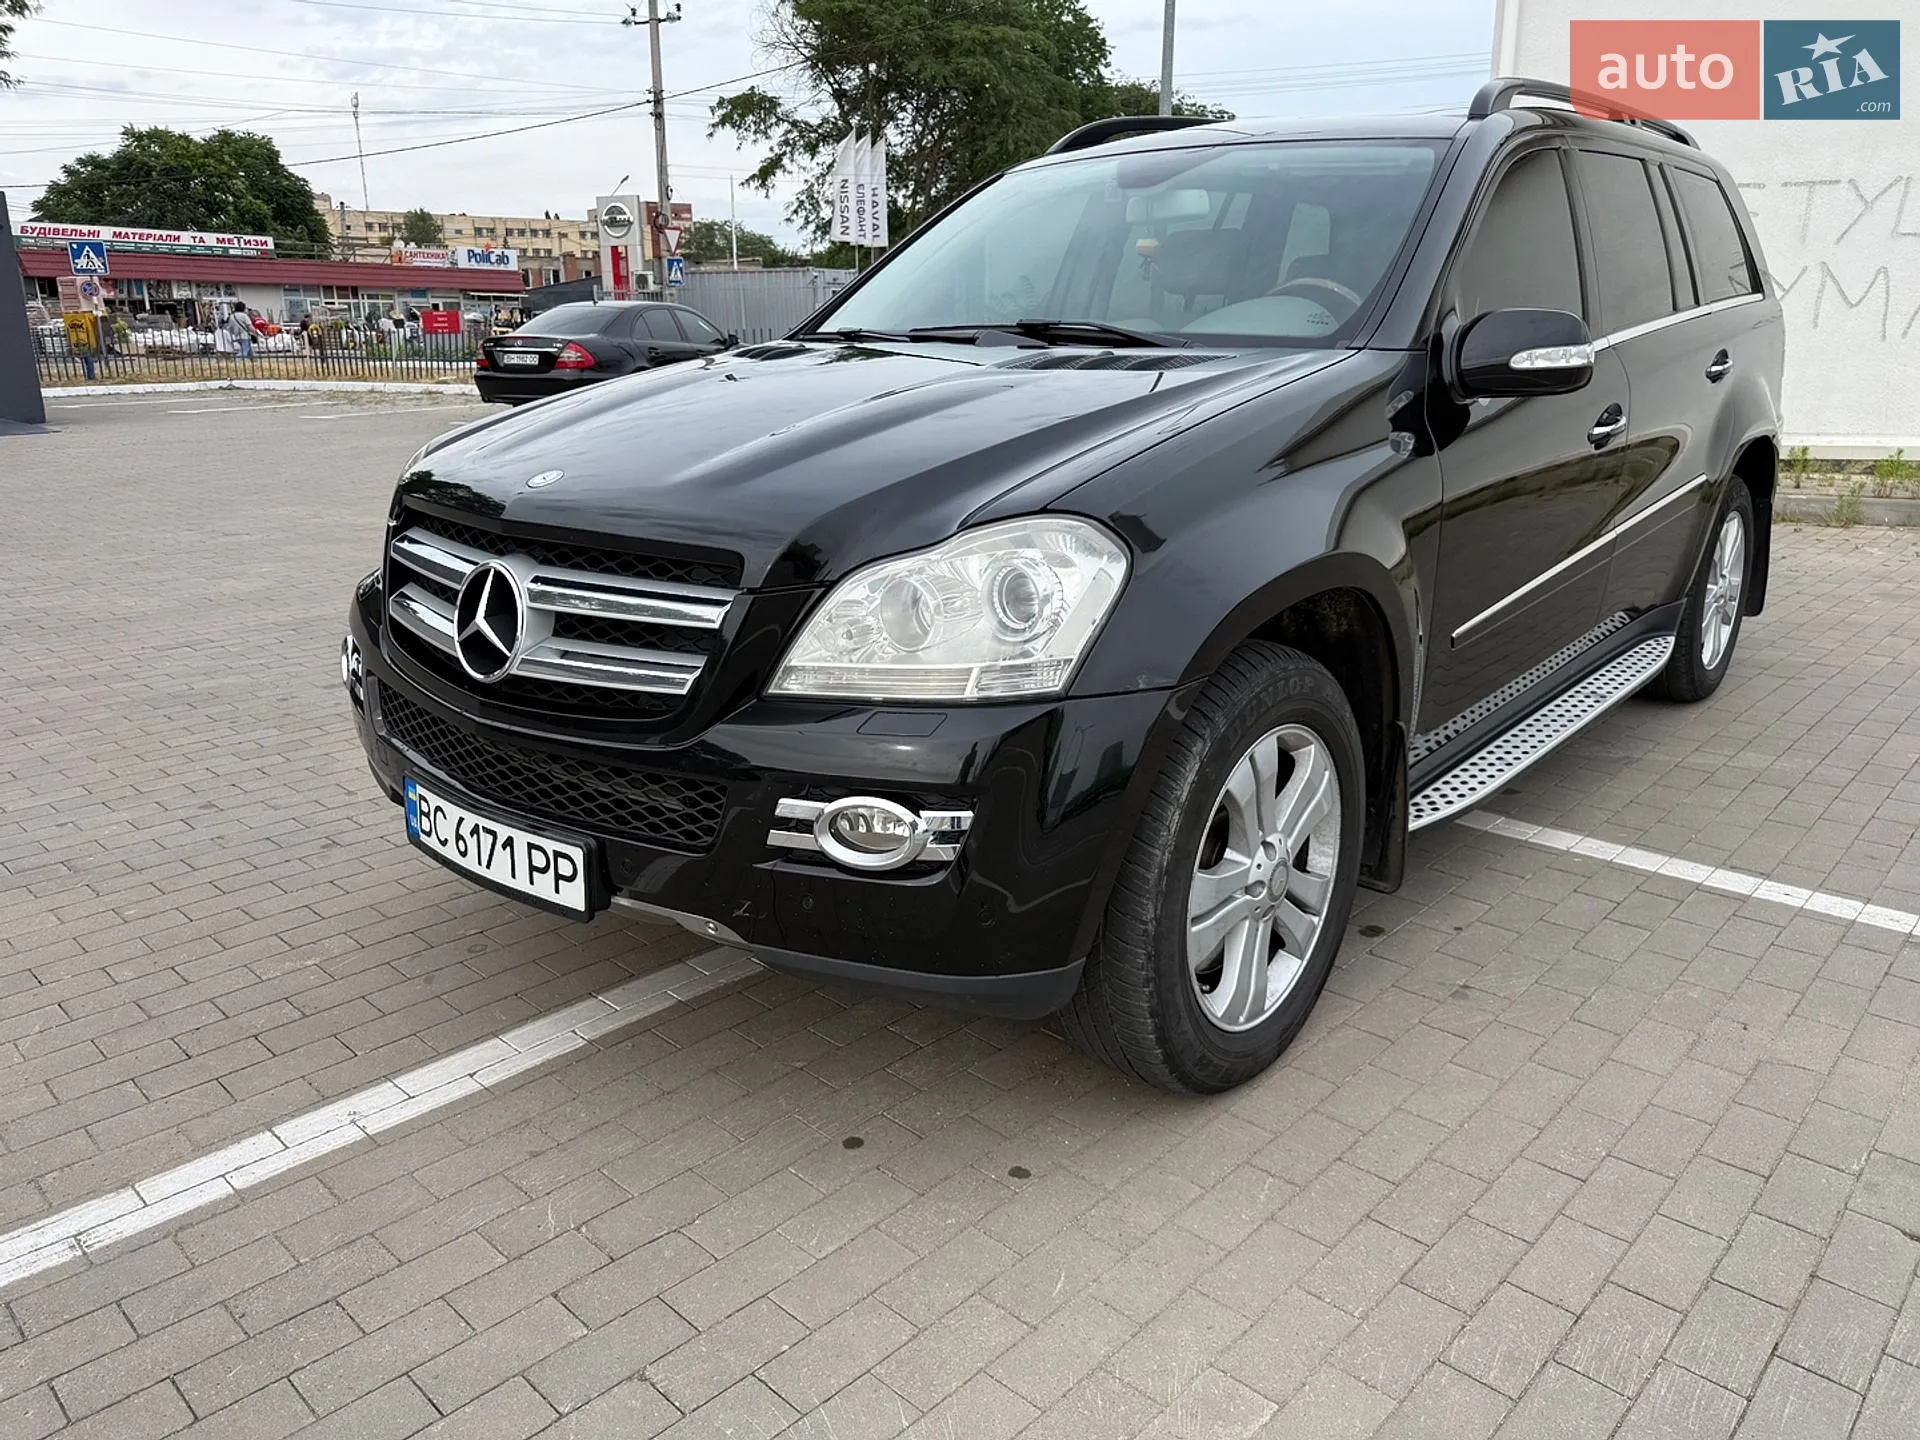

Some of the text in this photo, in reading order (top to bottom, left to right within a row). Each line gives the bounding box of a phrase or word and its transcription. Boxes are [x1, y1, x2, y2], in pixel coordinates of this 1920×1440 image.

[840, 178, 850, 236] NISSAN
[871, 186, 880, 241] HAVAL
[20, 225, 268, 247] БУДІВЕЛЬНІ МАТЕРІАЛИ ТА МЕТИЗИ
[467, 249, 510, 266] PoliCab
[418, 793, 579, 895] BC 6171 PP
